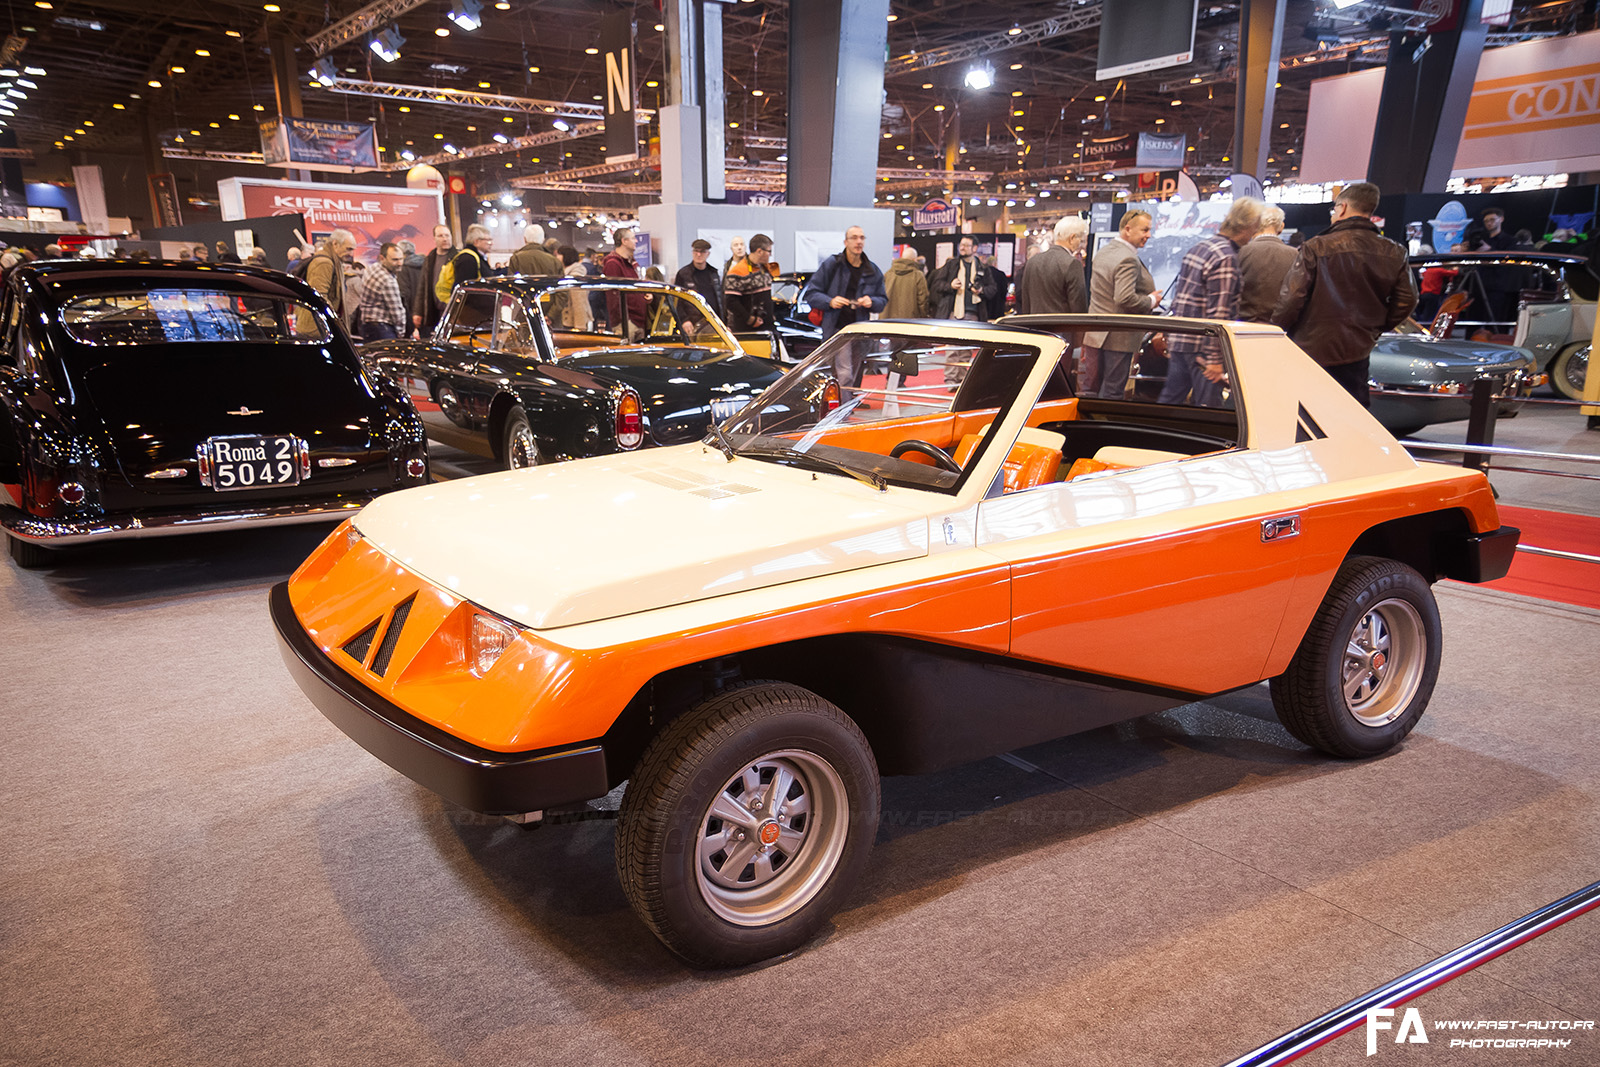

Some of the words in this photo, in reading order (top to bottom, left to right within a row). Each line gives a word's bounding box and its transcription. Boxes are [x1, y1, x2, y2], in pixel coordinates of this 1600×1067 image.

[605, 47, 631, 115] N
[293, 120, 361, 134] KIENLE
[1084, 142, 1124, 156] FISKENS
[1140, 140, 1173, 150] FISKENS
[273, 195, 382, 211] KIENLE
[916, 208, 956, 225] RALLYSTORY
[274, 438, 291, 460] 2
[218, 460, 293, 487] 5049
